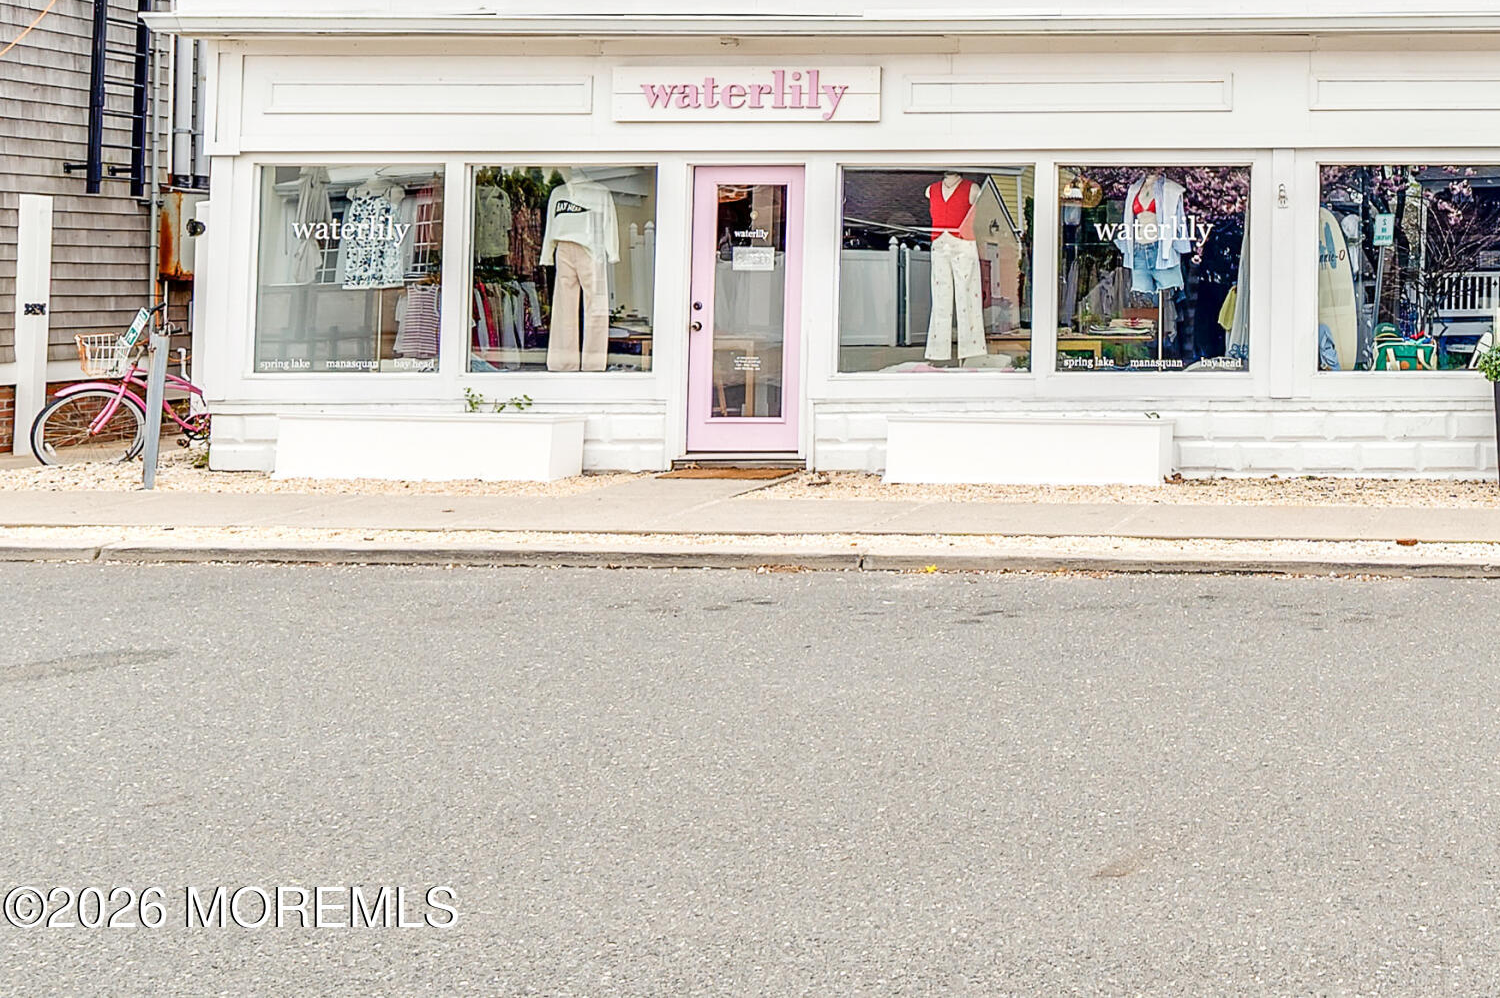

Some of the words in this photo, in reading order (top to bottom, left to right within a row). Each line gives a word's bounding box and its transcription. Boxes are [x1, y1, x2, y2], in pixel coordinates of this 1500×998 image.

[640, 69, 850, 121] waterlily
[292, 215, 411, 246] waterlily
[734, 229, 769, 242] waterlily
[1094, 215, 1214, 247] waterlily
[259, 358, 290, 370] spring
[291, 357, 311, 368] lake
[326, 359, 380, 370] manasquan
[393, 358, 412, 370] bay
[412, 358, 435, 369] head
[1063, 357, 1093, 369] spring
[1095, 357, 1115, 368] lake
[1130, 358, 1183, 370] manasquan
[1200, 357, 1220, 369] bay
[1219, 357, 1242, 368] head
